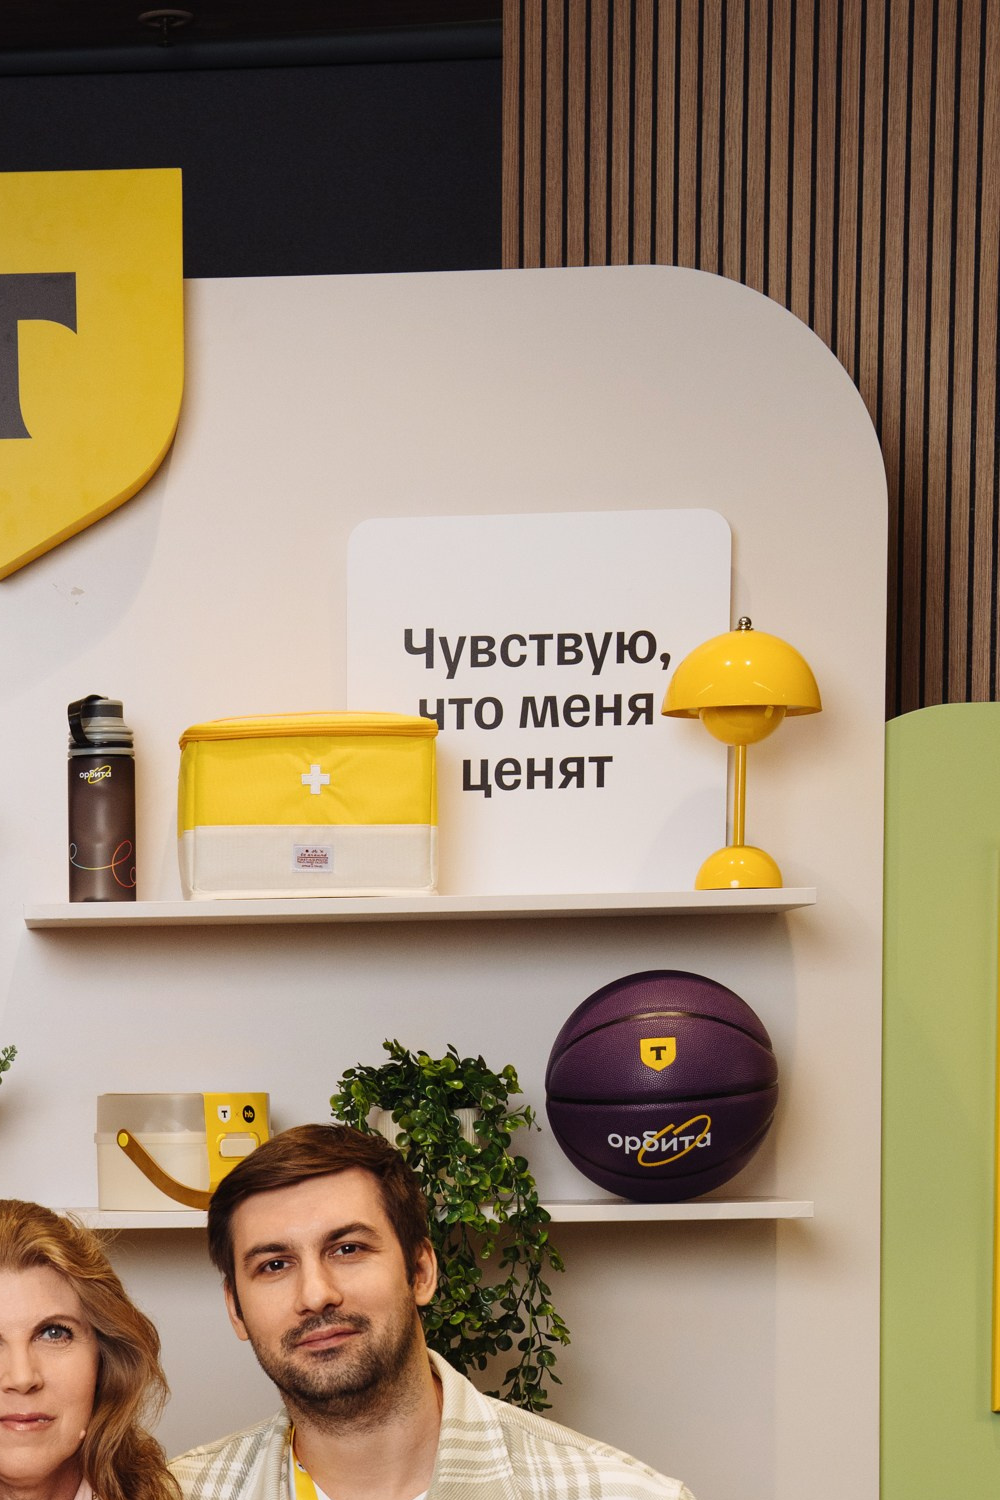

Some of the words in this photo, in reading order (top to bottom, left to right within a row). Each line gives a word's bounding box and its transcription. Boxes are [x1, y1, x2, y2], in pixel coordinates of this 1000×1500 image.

[404, 628, 671, 680] Чувствую,
[419, 696, 504, 731] что
[519, 692, 654, 729] меня
[79, 768, 112, 781] орбита
[462, 755, 613, 799] ценят
[607, 1128, 712, 1156] орбита
